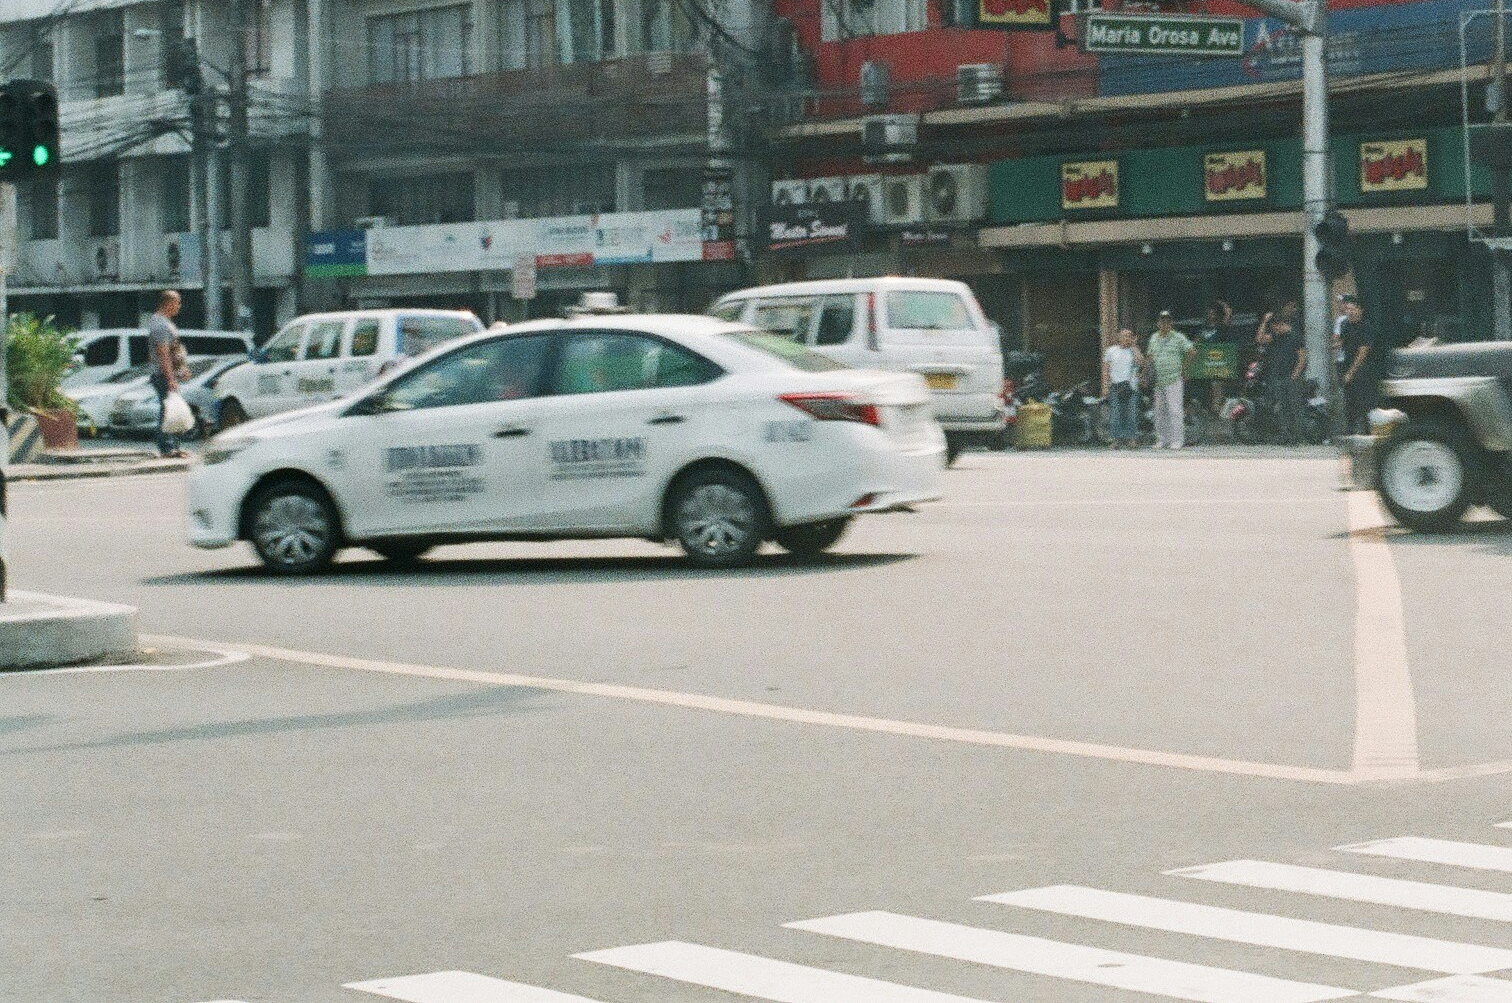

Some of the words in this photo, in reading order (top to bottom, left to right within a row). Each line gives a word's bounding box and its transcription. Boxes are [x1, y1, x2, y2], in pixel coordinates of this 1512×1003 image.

[1093, 25, 1140, 44] Maria
[1149, 25, 1199, 45] Orosa
[1209, 27, 1240, 45] Ave
